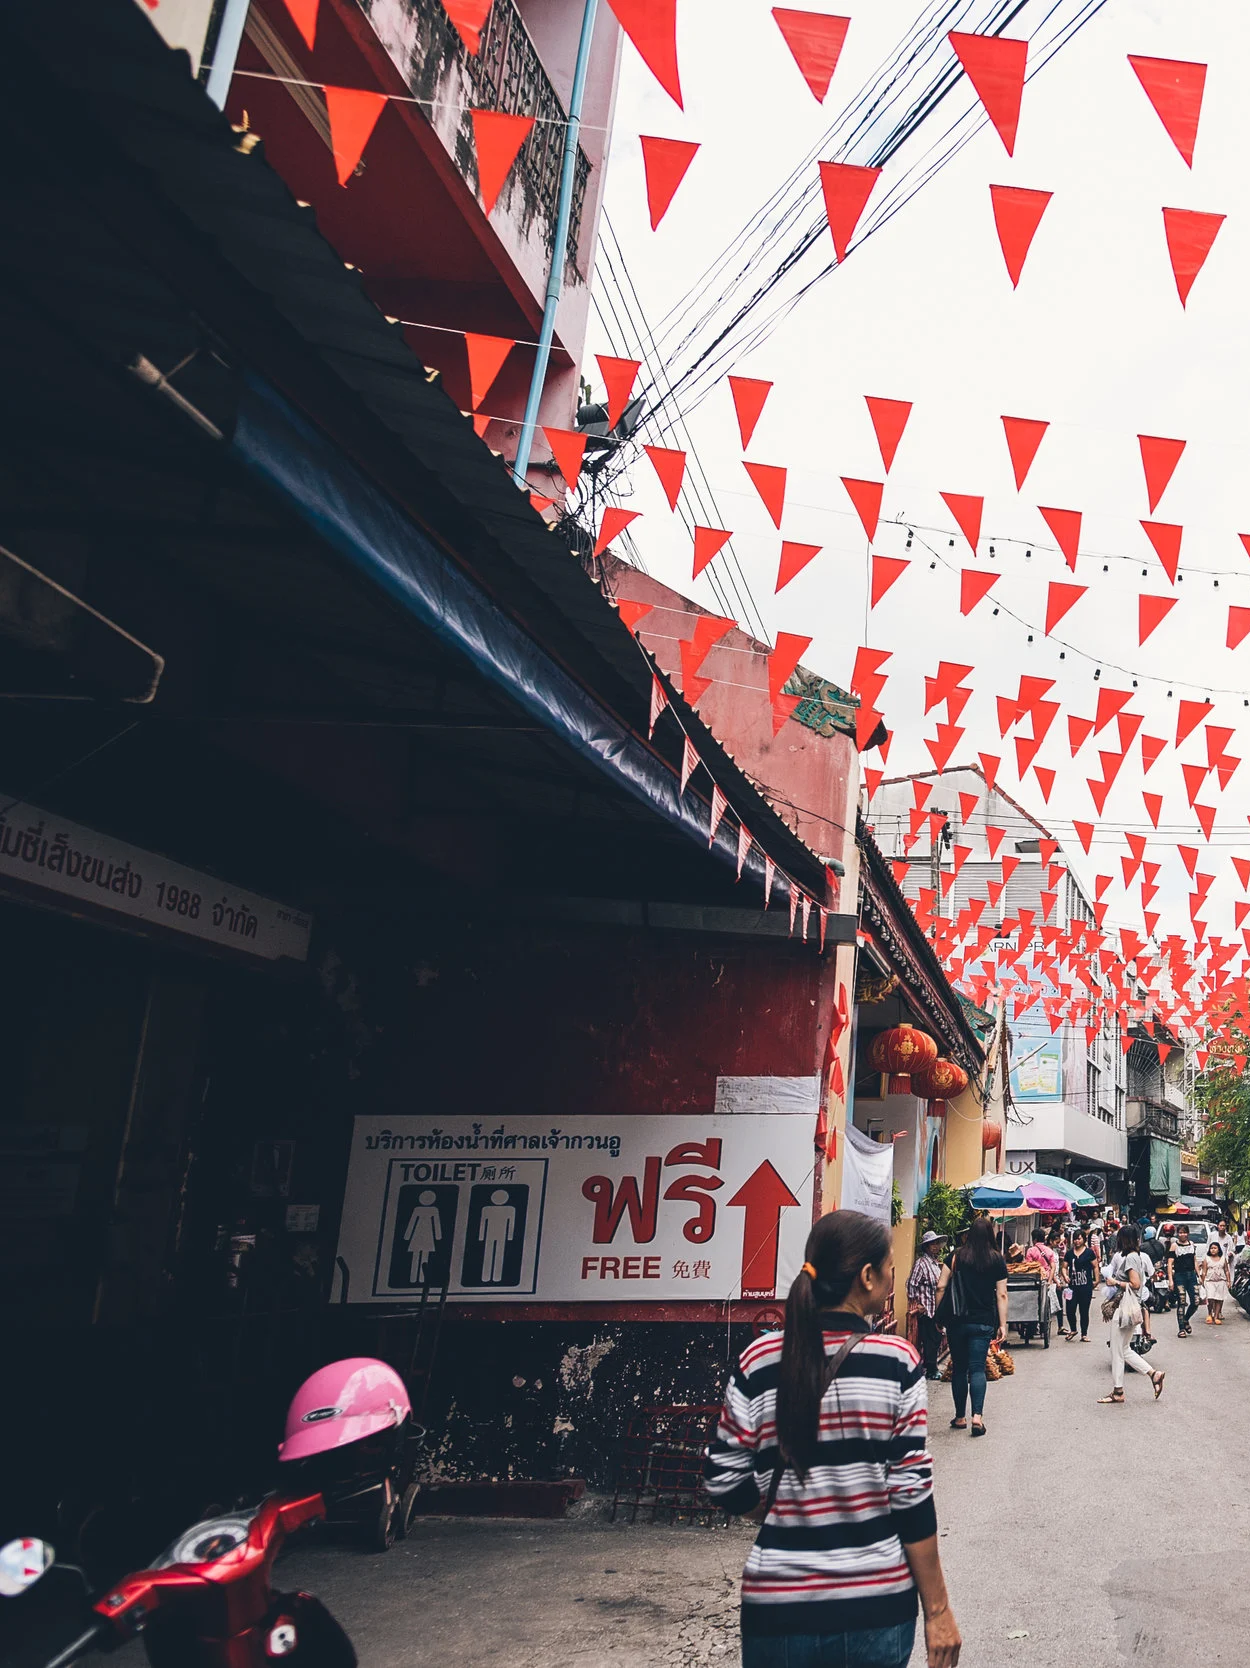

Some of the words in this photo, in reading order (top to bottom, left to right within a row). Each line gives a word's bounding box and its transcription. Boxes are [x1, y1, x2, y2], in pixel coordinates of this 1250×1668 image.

[156, 881, 201, 920] 1988
[212, 897, 258, 938] จำกัด
[365, 1123, 620, 1157] บริการห้องน้ำที่ศาลเจ้ากวนอู
[400, 1163, 481, 1182] TOILET
[582, 1138, 725, 1244] ฟรี
[581, 1256, 661, 1279] FREE
[671, 1260, 711, 1279] 免費
